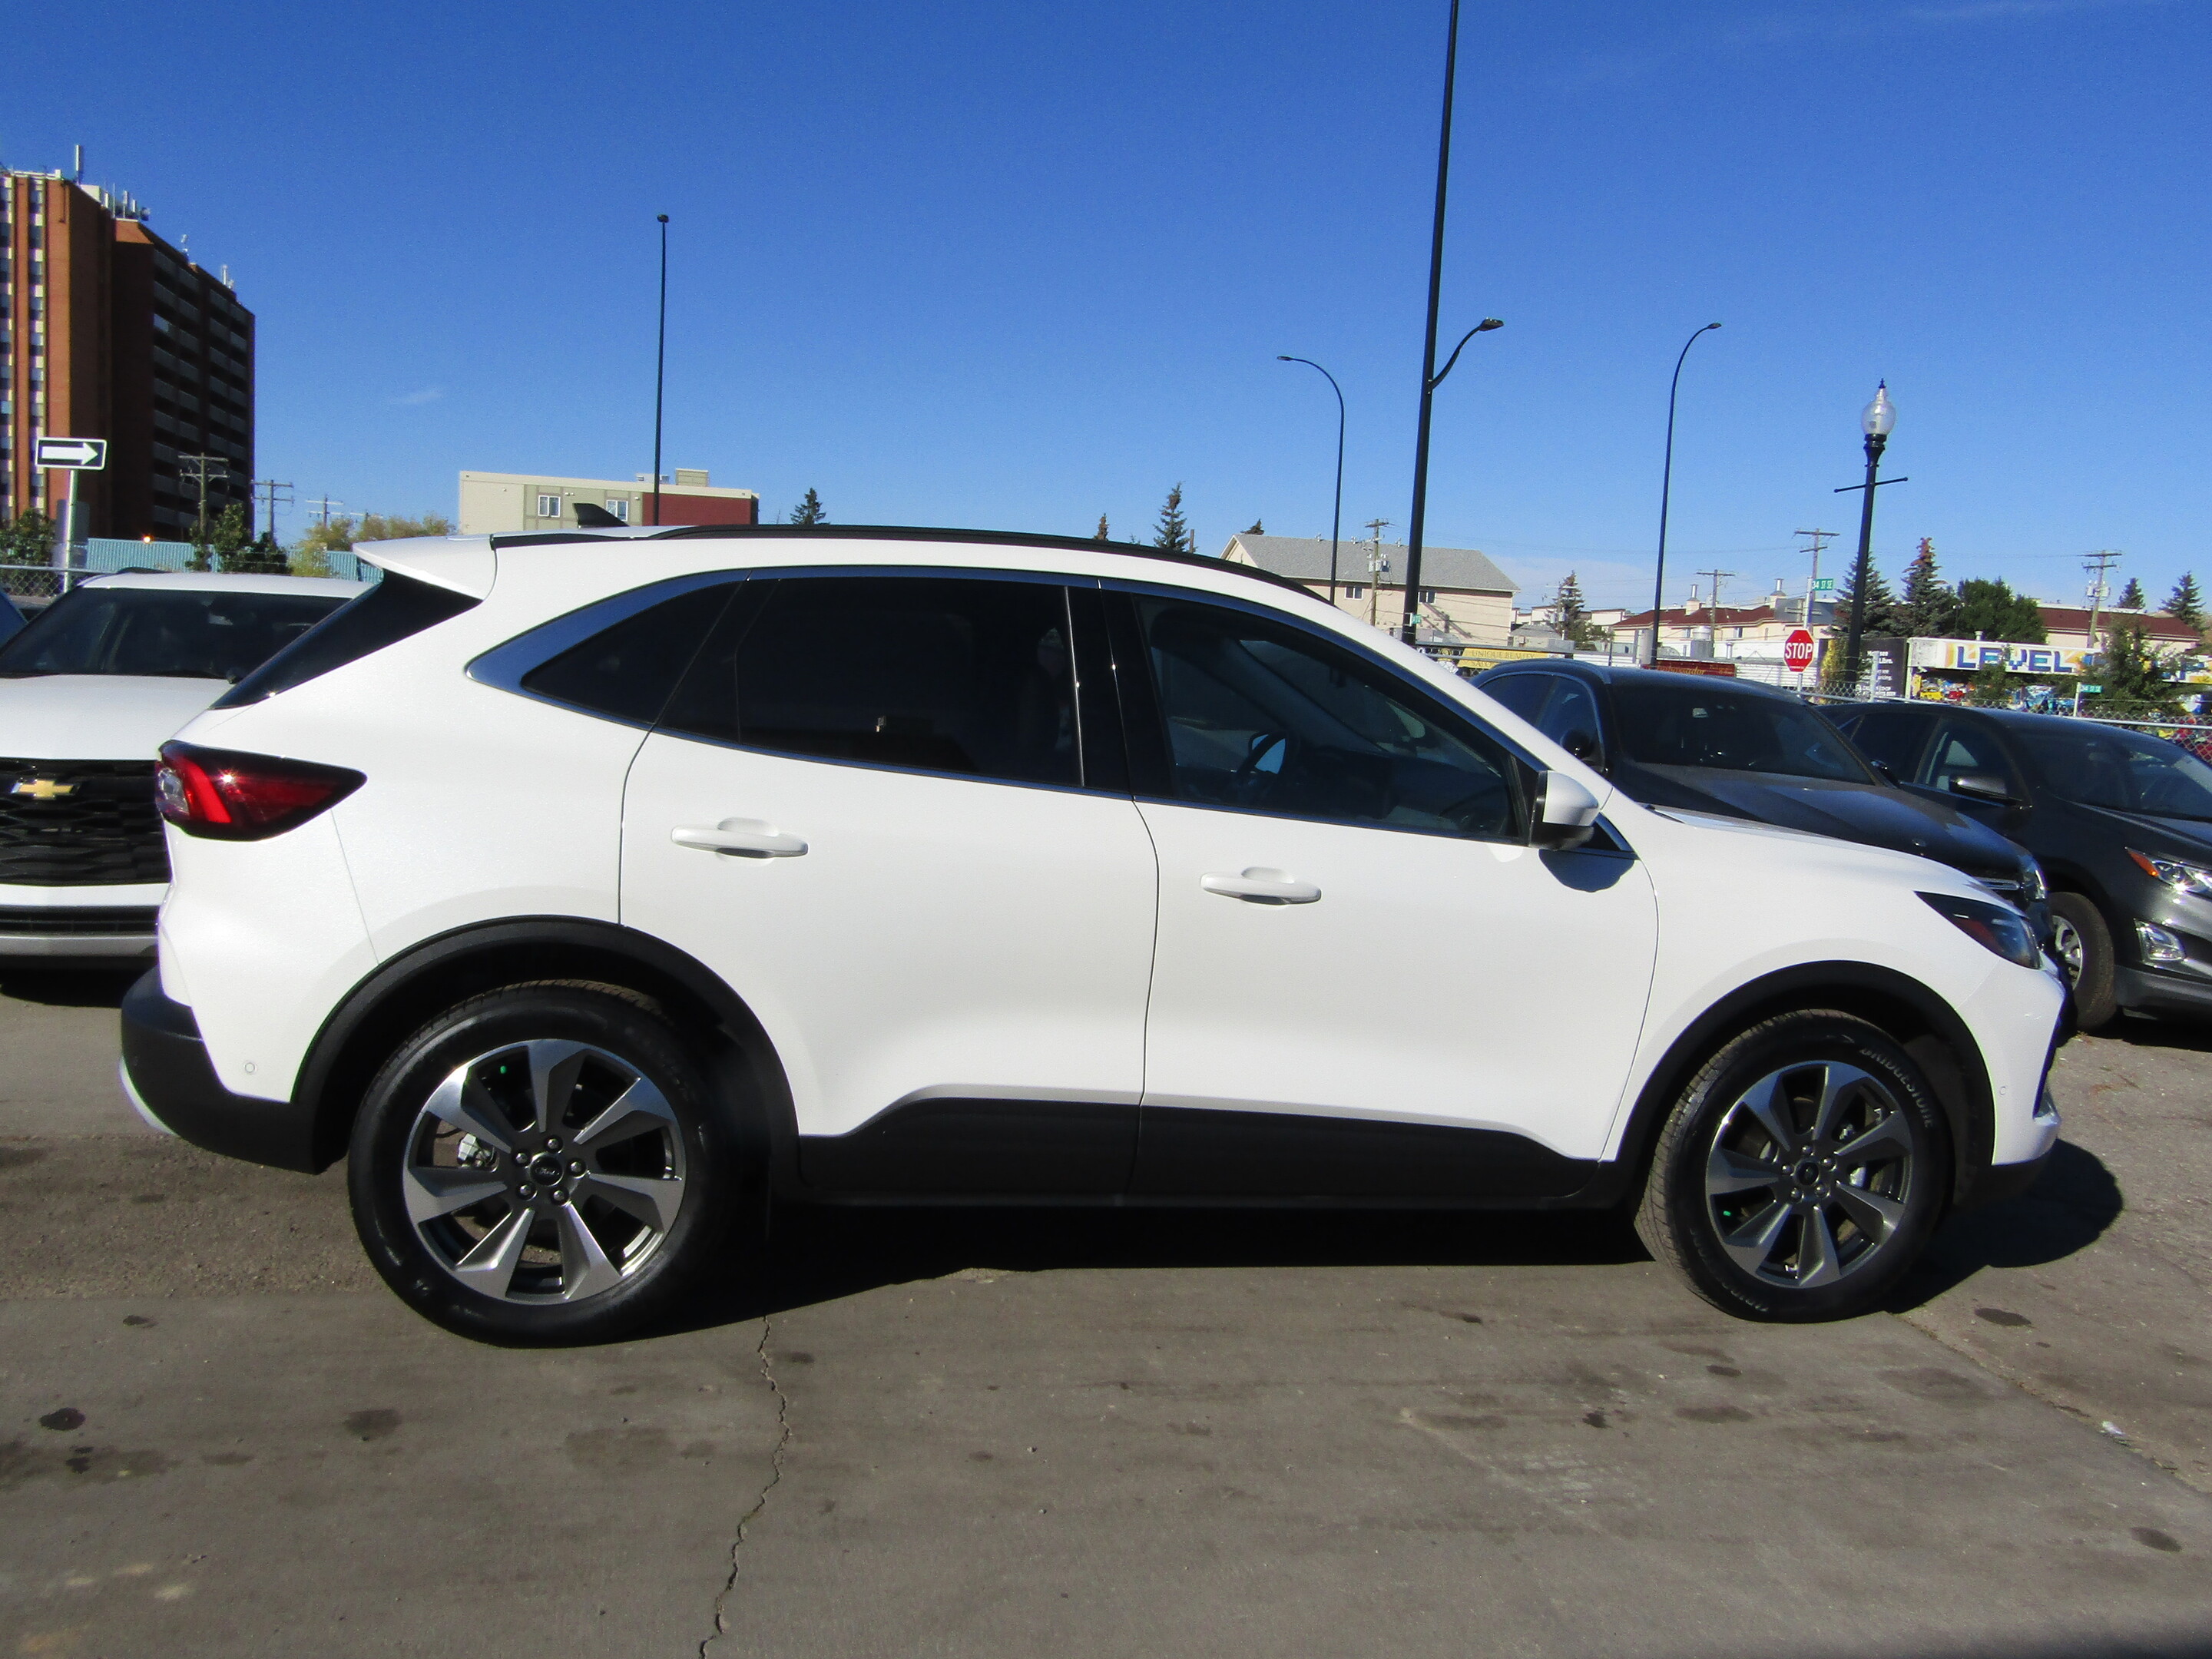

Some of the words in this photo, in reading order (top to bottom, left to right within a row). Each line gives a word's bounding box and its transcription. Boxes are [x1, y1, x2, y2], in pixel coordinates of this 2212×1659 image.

[1472, 650, 1505, 658] UNIQUE
[1785, 642, 1813, 659] STOP
[1957, 646, 2072, 673] LEVEL
